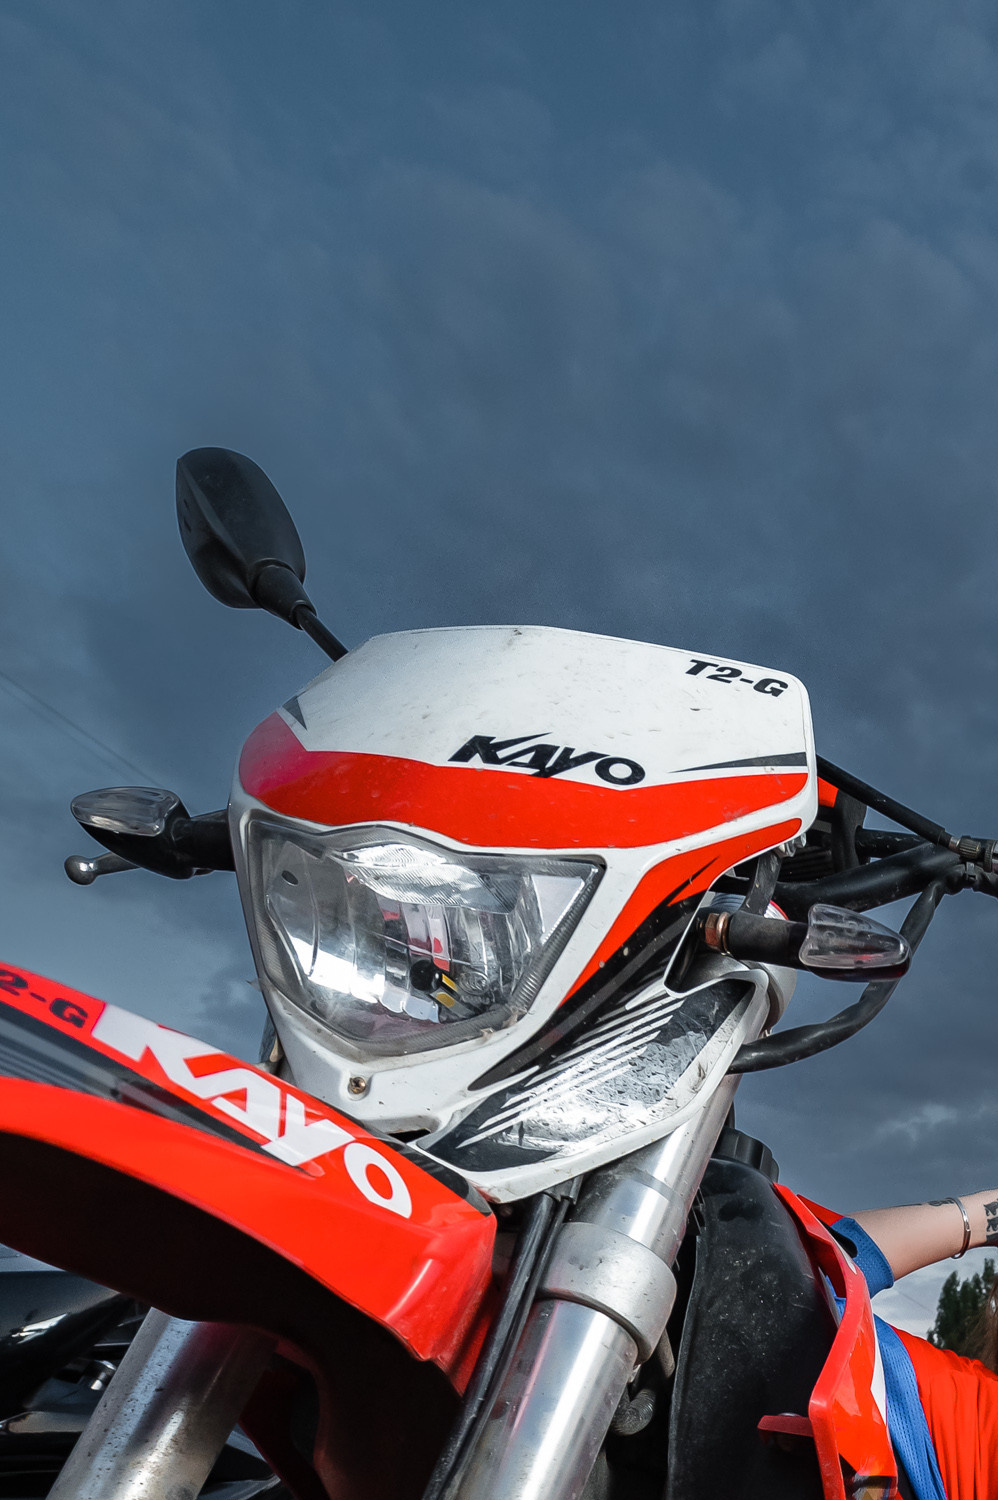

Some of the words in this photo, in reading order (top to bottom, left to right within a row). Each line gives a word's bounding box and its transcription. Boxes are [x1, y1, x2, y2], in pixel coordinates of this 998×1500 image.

[685, 658, 790, 698] T2-G
[447, 731, 647, 786] KAYO
[91, 1002, 413, 1220] KAYO
